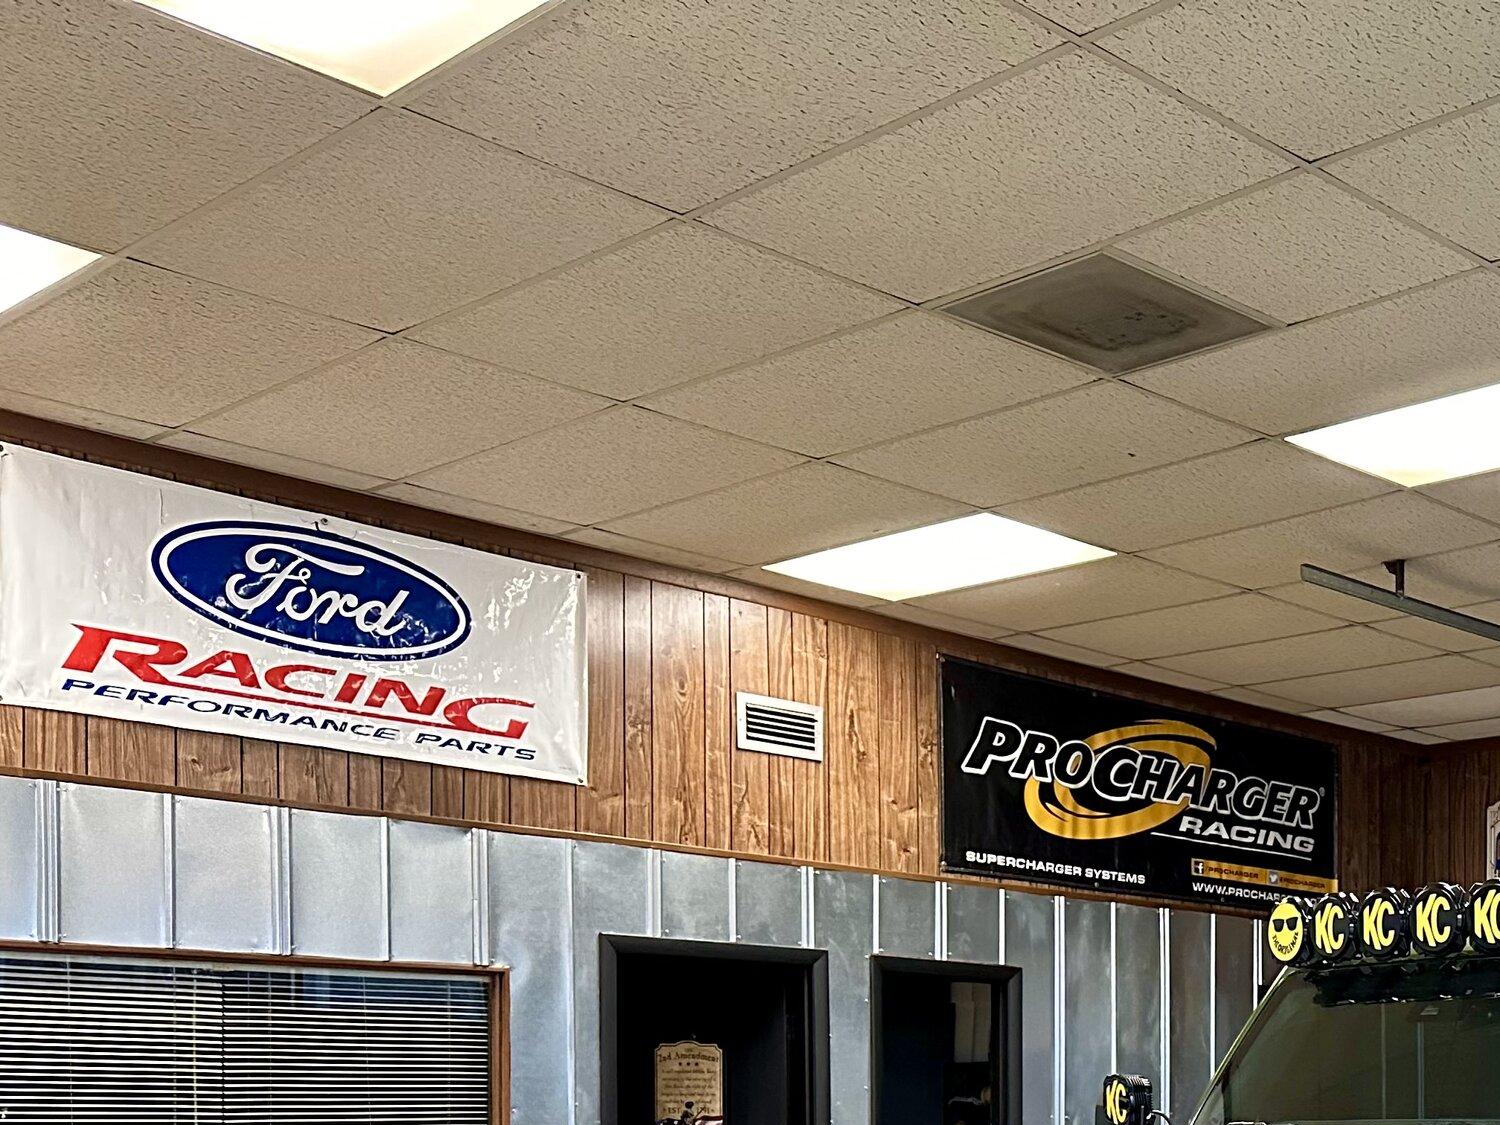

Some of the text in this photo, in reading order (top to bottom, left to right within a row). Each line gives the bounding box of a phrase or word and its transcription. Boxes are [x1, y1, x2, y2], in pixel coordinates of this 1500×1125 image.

[226, 542, 410, 637] Ford
[61, 623, 536, 741] RACING
[61, 678, 537, 762] PERFORMANCE PARTS
[960, 716, 1321, 830] PROCHARGER
[1178, 816, 1316, 855] RACING
[965, 851, 1146, 886] SUPERCHARGER SYSTEMS
[1314, 902, 1345, 954] KC
[1362, 898, 1395, 950] KC
[1415, 893, 1451, 947] KC
[1105, 1079, 1128, 1125] KC
